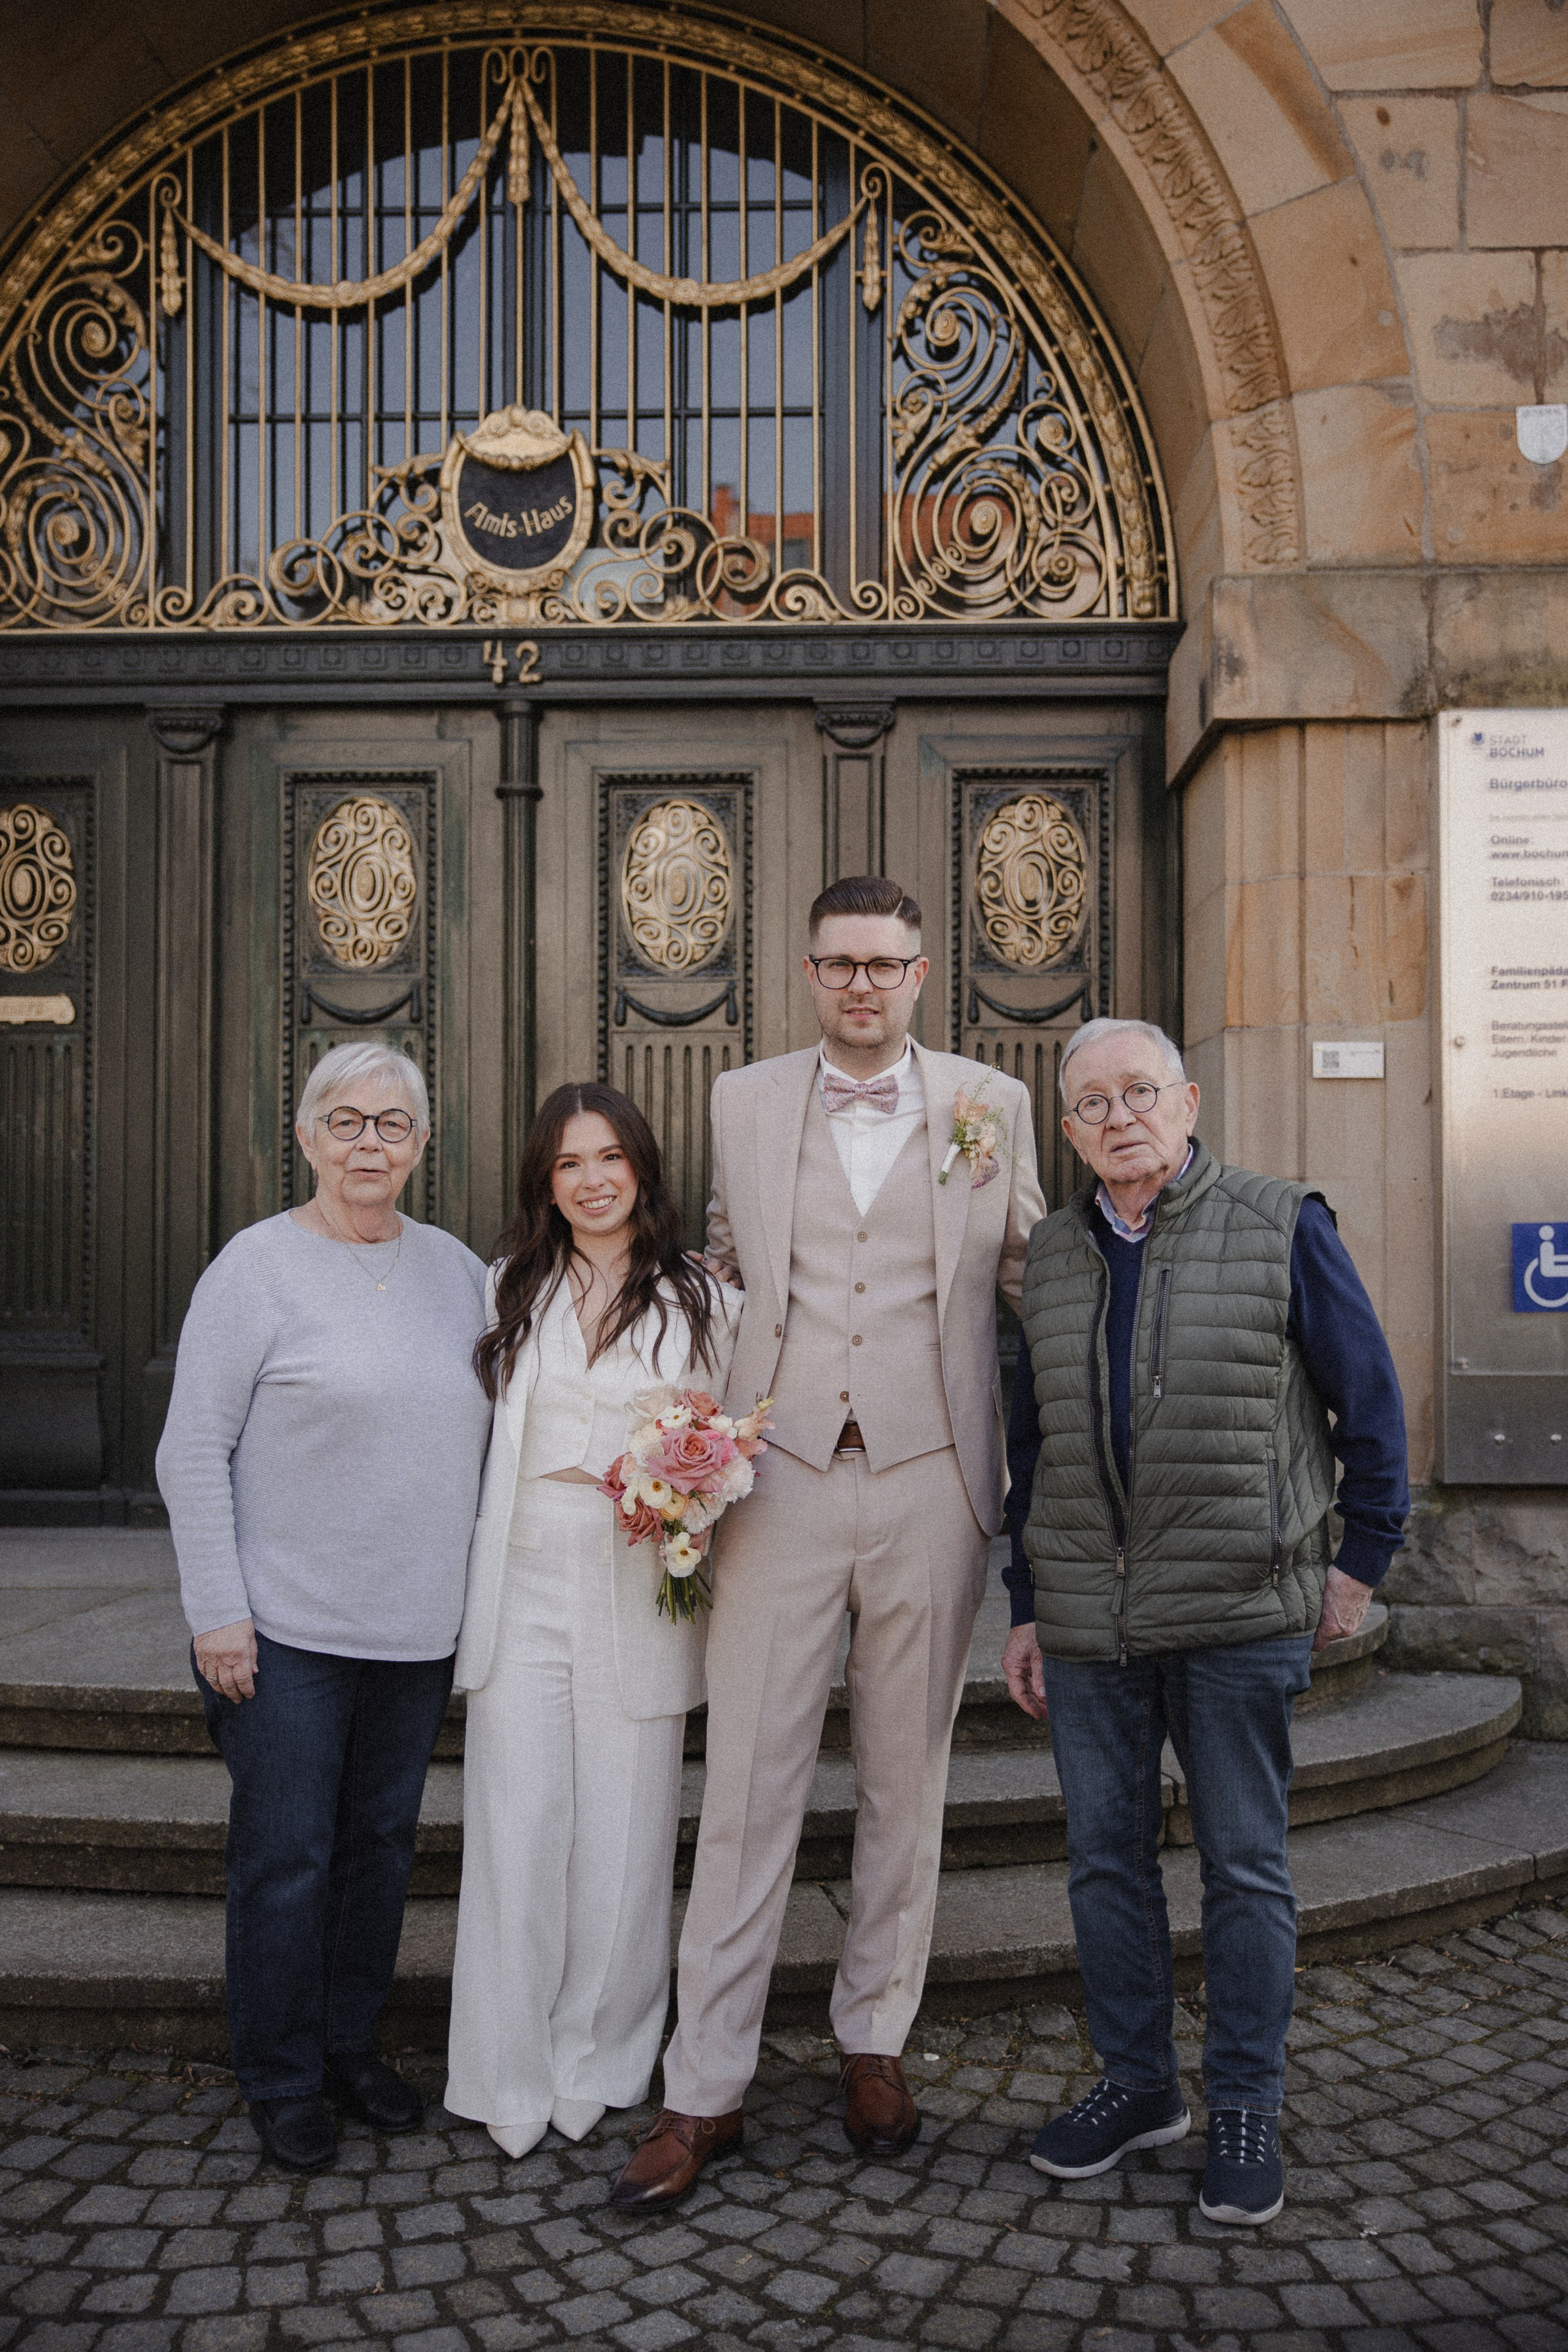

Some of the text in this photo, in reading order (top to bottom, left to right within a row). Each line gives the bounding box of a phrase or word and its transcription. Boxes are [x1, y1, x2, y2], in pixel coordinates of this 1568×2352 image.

[483, 639, 541, 684] 42
[1490, 735, 1527, 745] STADT
[1490, 747, 1544, 758] BOCHUM
[1490, 778, 1568, 791] Bürgerbüro
[1490, 835, 1529, 845] Online
[1493, 876, 1560, 887] Telefonisch
[1491, 979, 1540, 990] Zentrum
[1491, 1047, 1558, 1059] Jugendliche
[1502, 1087, 1535, 1100] Etage
